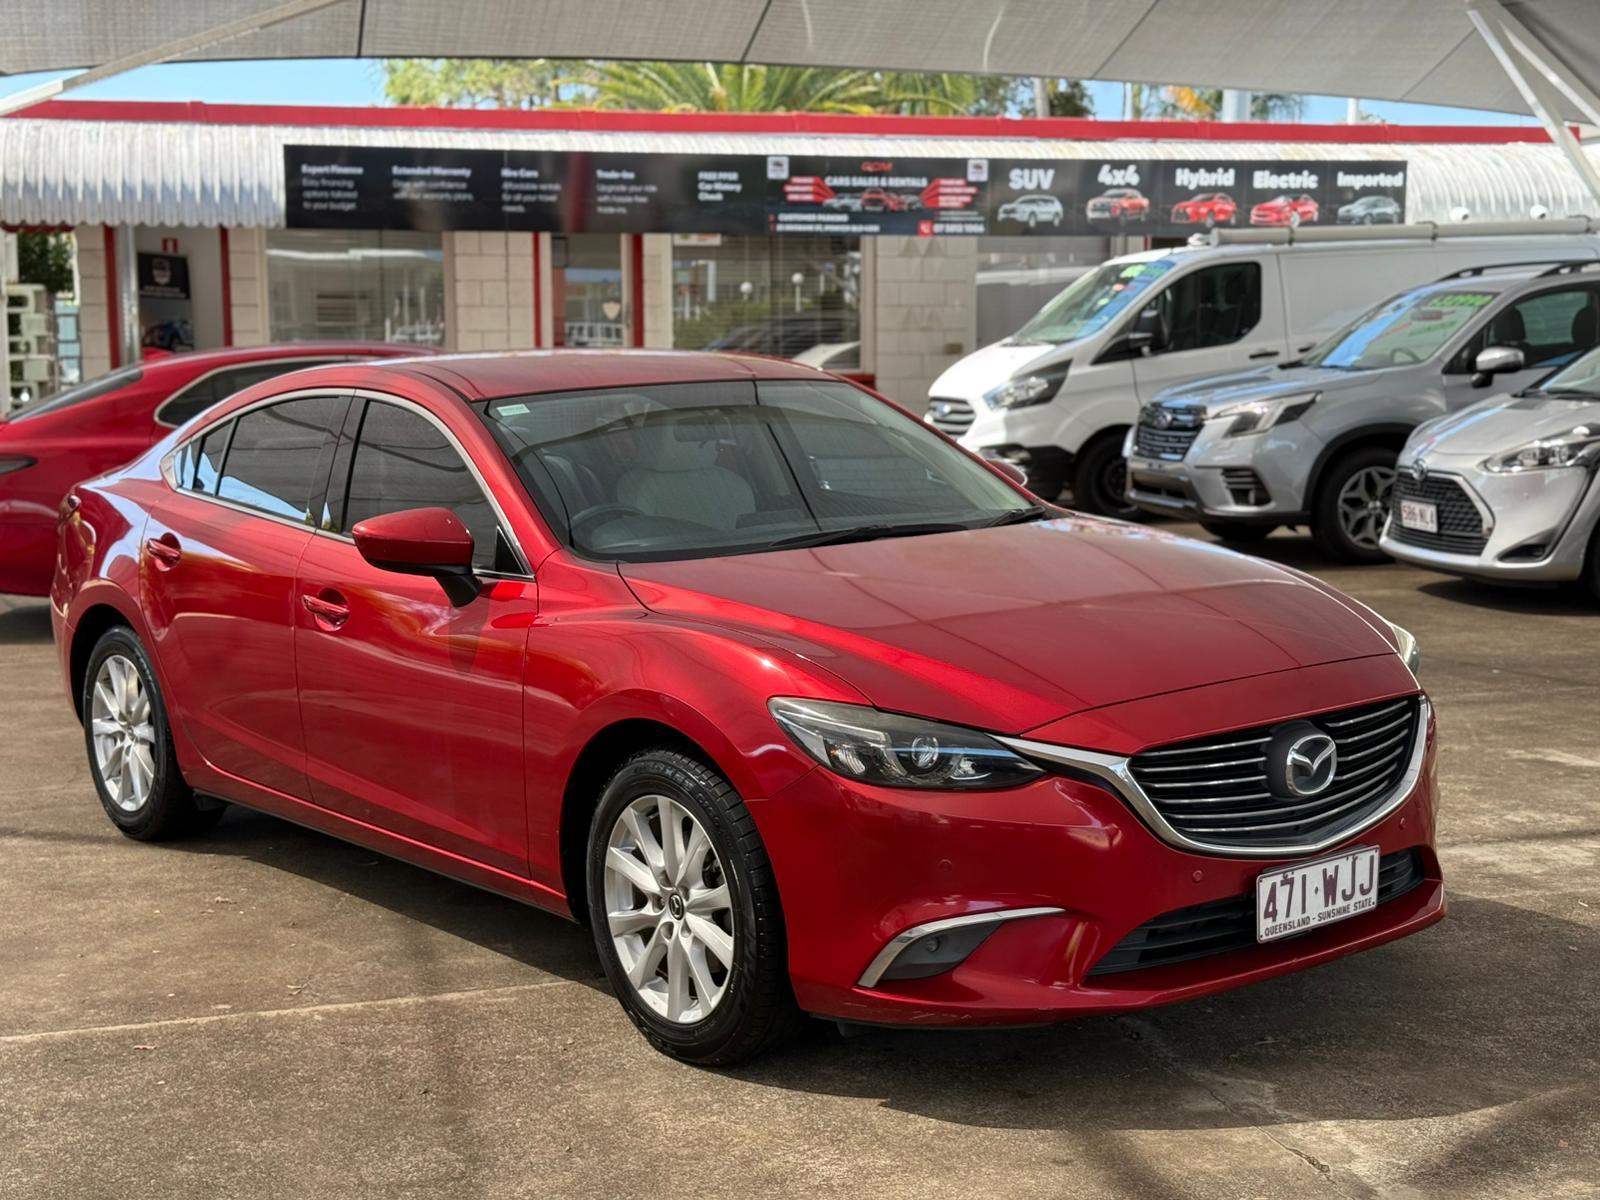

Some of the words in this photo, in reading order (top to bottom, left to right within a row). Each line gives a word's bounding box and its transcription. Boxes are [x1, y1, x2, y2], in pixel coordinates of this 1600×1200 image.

[331, 164, 364, 174] Finance
[392, 165, 431, 176] Extended
[432, 166, 472, 178] Warranty
[1008, 168, 1055, 190] SUV
[1098, 164, 1140, 186] 4x4
[1175, 168, 1235, 190] Hybrid
[1253, 170, 1318, 189] Electric
[1337, 171, 1404, 190] Imported
[1264, 916, 1310, 937] QUEENSLAND
[1317, 906, 1351, 922] SUNSHINE
[1353, 897, 1373, 911] STATE
